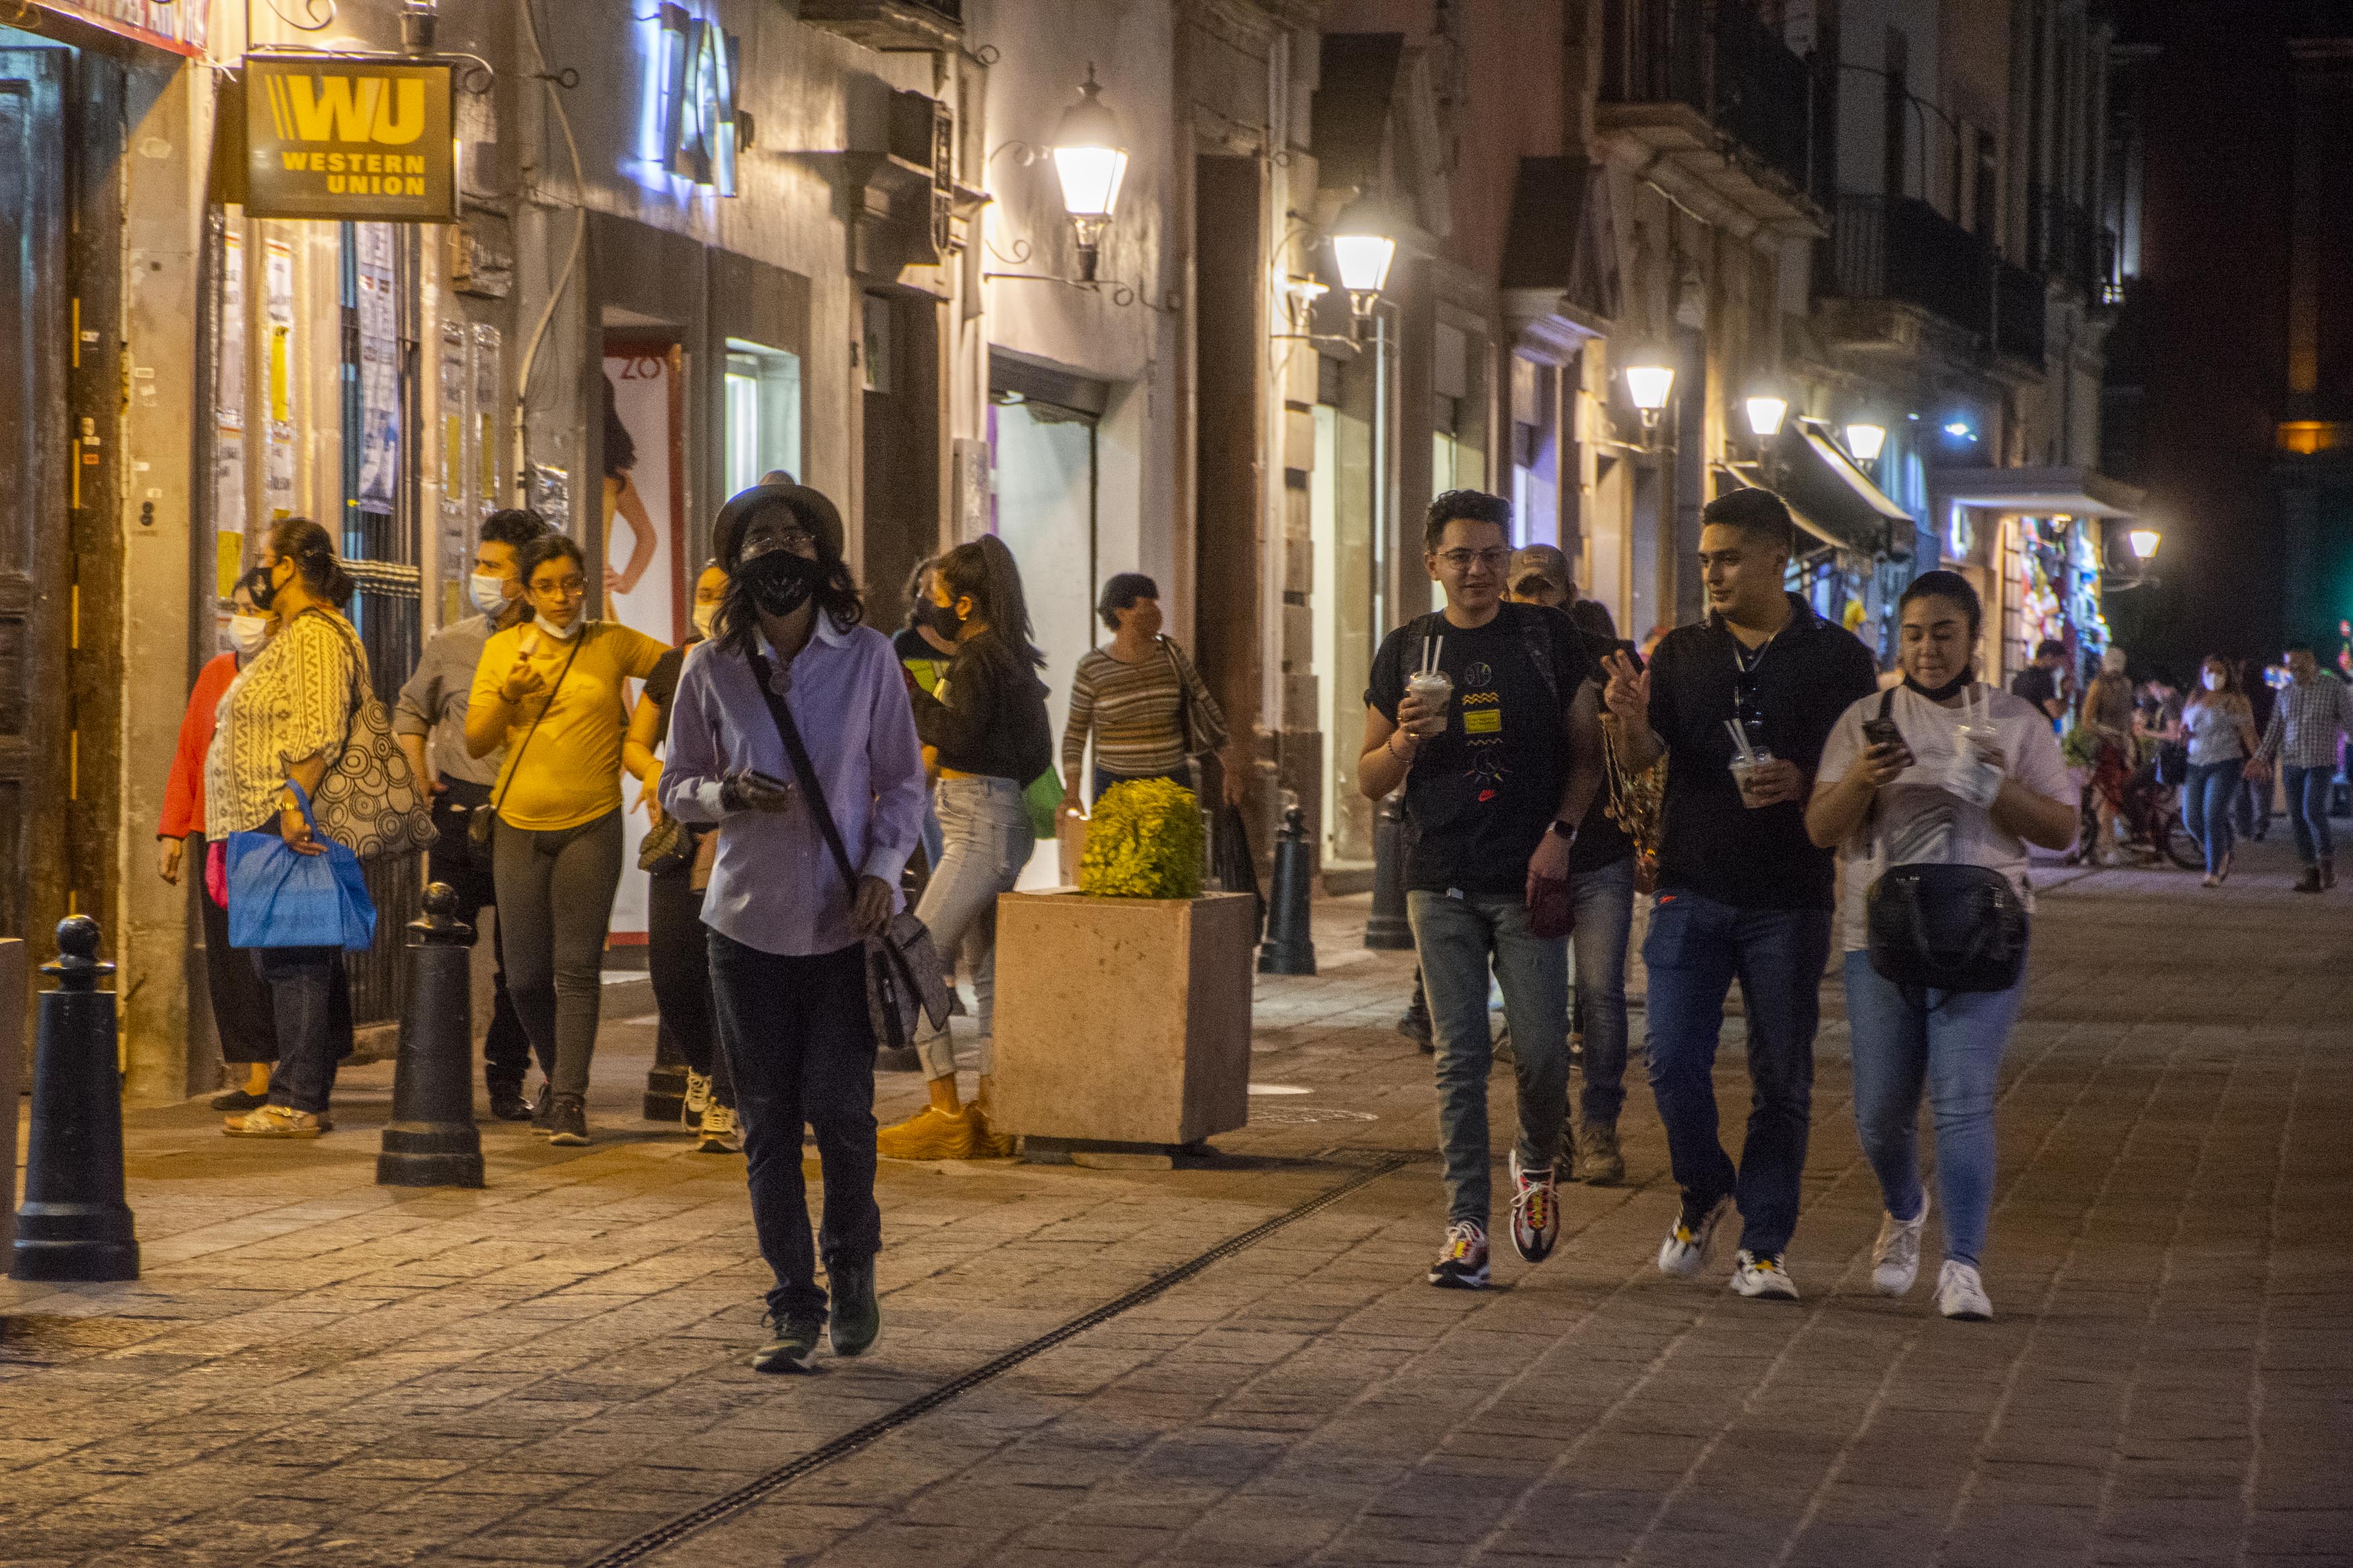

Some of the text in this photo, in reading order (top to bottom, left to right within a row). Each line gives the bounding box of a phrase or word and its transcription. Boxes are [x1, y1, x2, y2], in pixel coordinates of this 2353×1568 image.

[286, 74, 426, 145] WU
[282, 151, 426, 174] WESTERN
[327, 175, 426, 196] UNION
